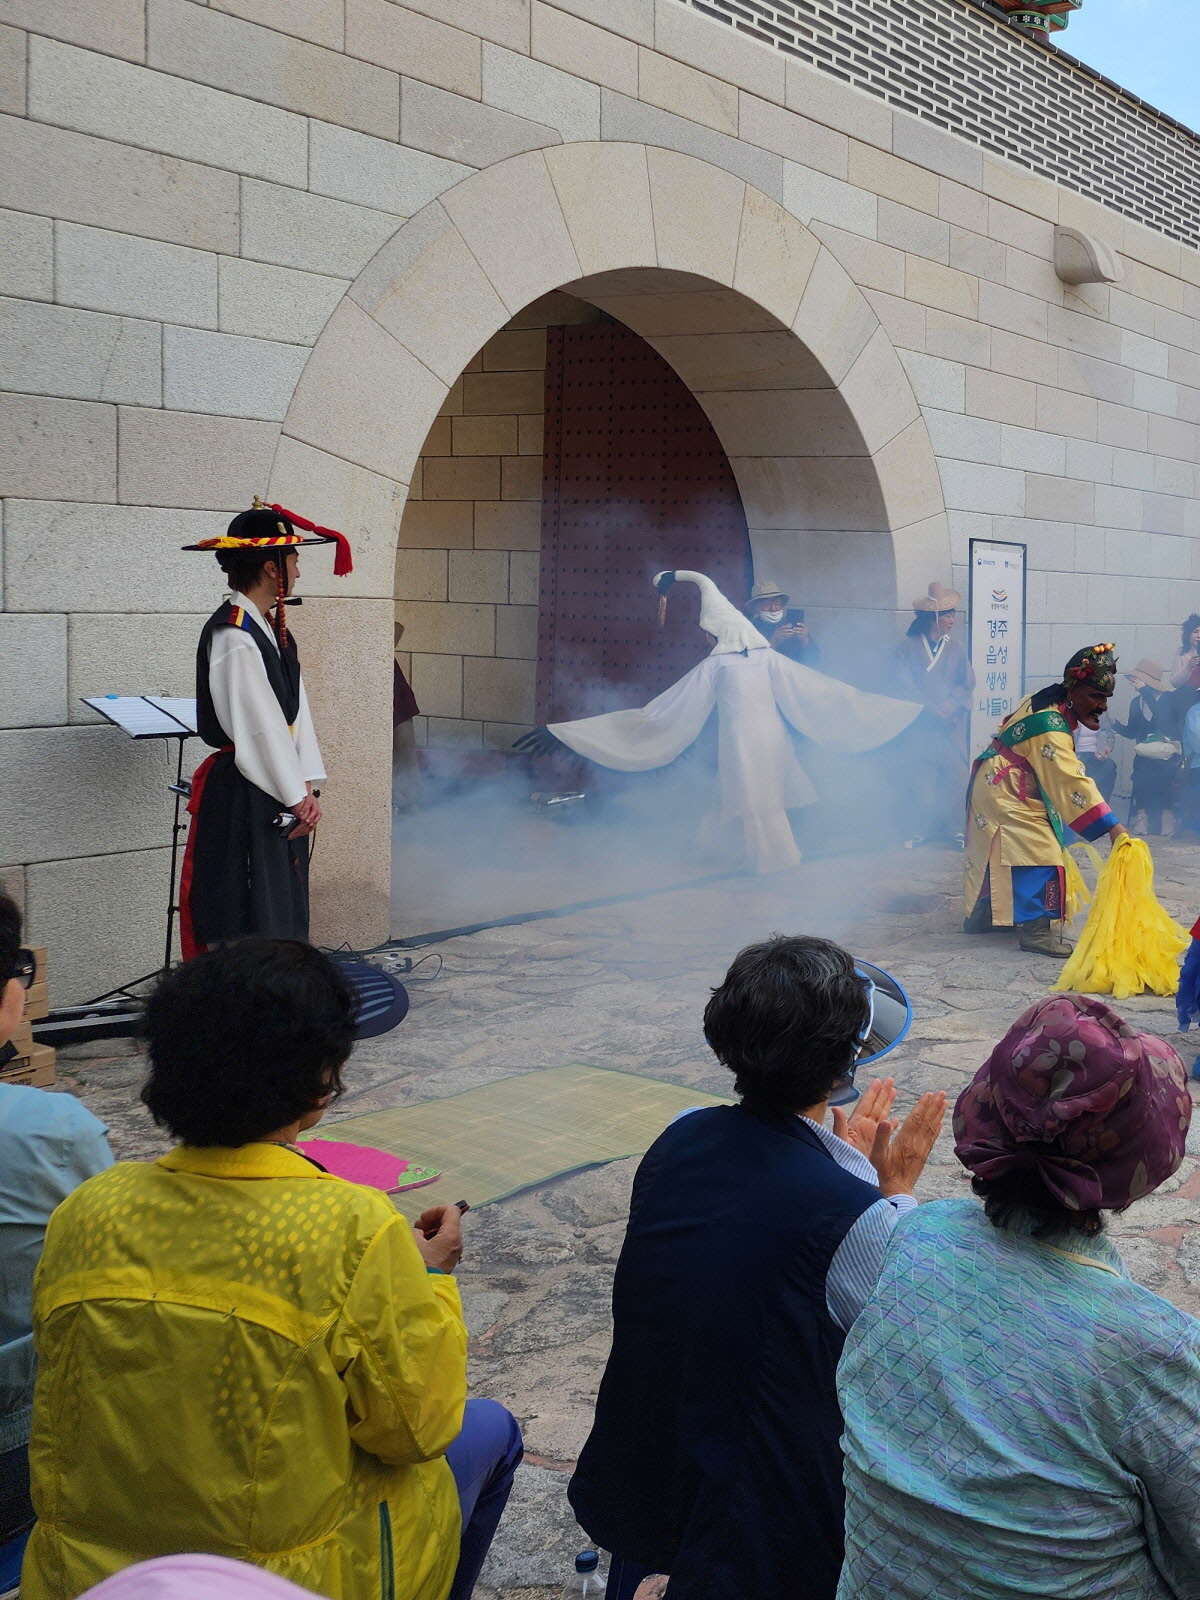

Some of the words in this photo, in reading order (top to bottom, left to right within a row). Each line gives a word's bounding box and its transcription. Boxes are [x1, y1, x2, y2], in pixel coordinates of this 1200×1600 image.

[987, 620, 1008, 639] 경주
[986, 645, 1008, 664] 읍성
[986, 672, 1007, 690] 생생
[979, 697, 1012, 716] 나들이
